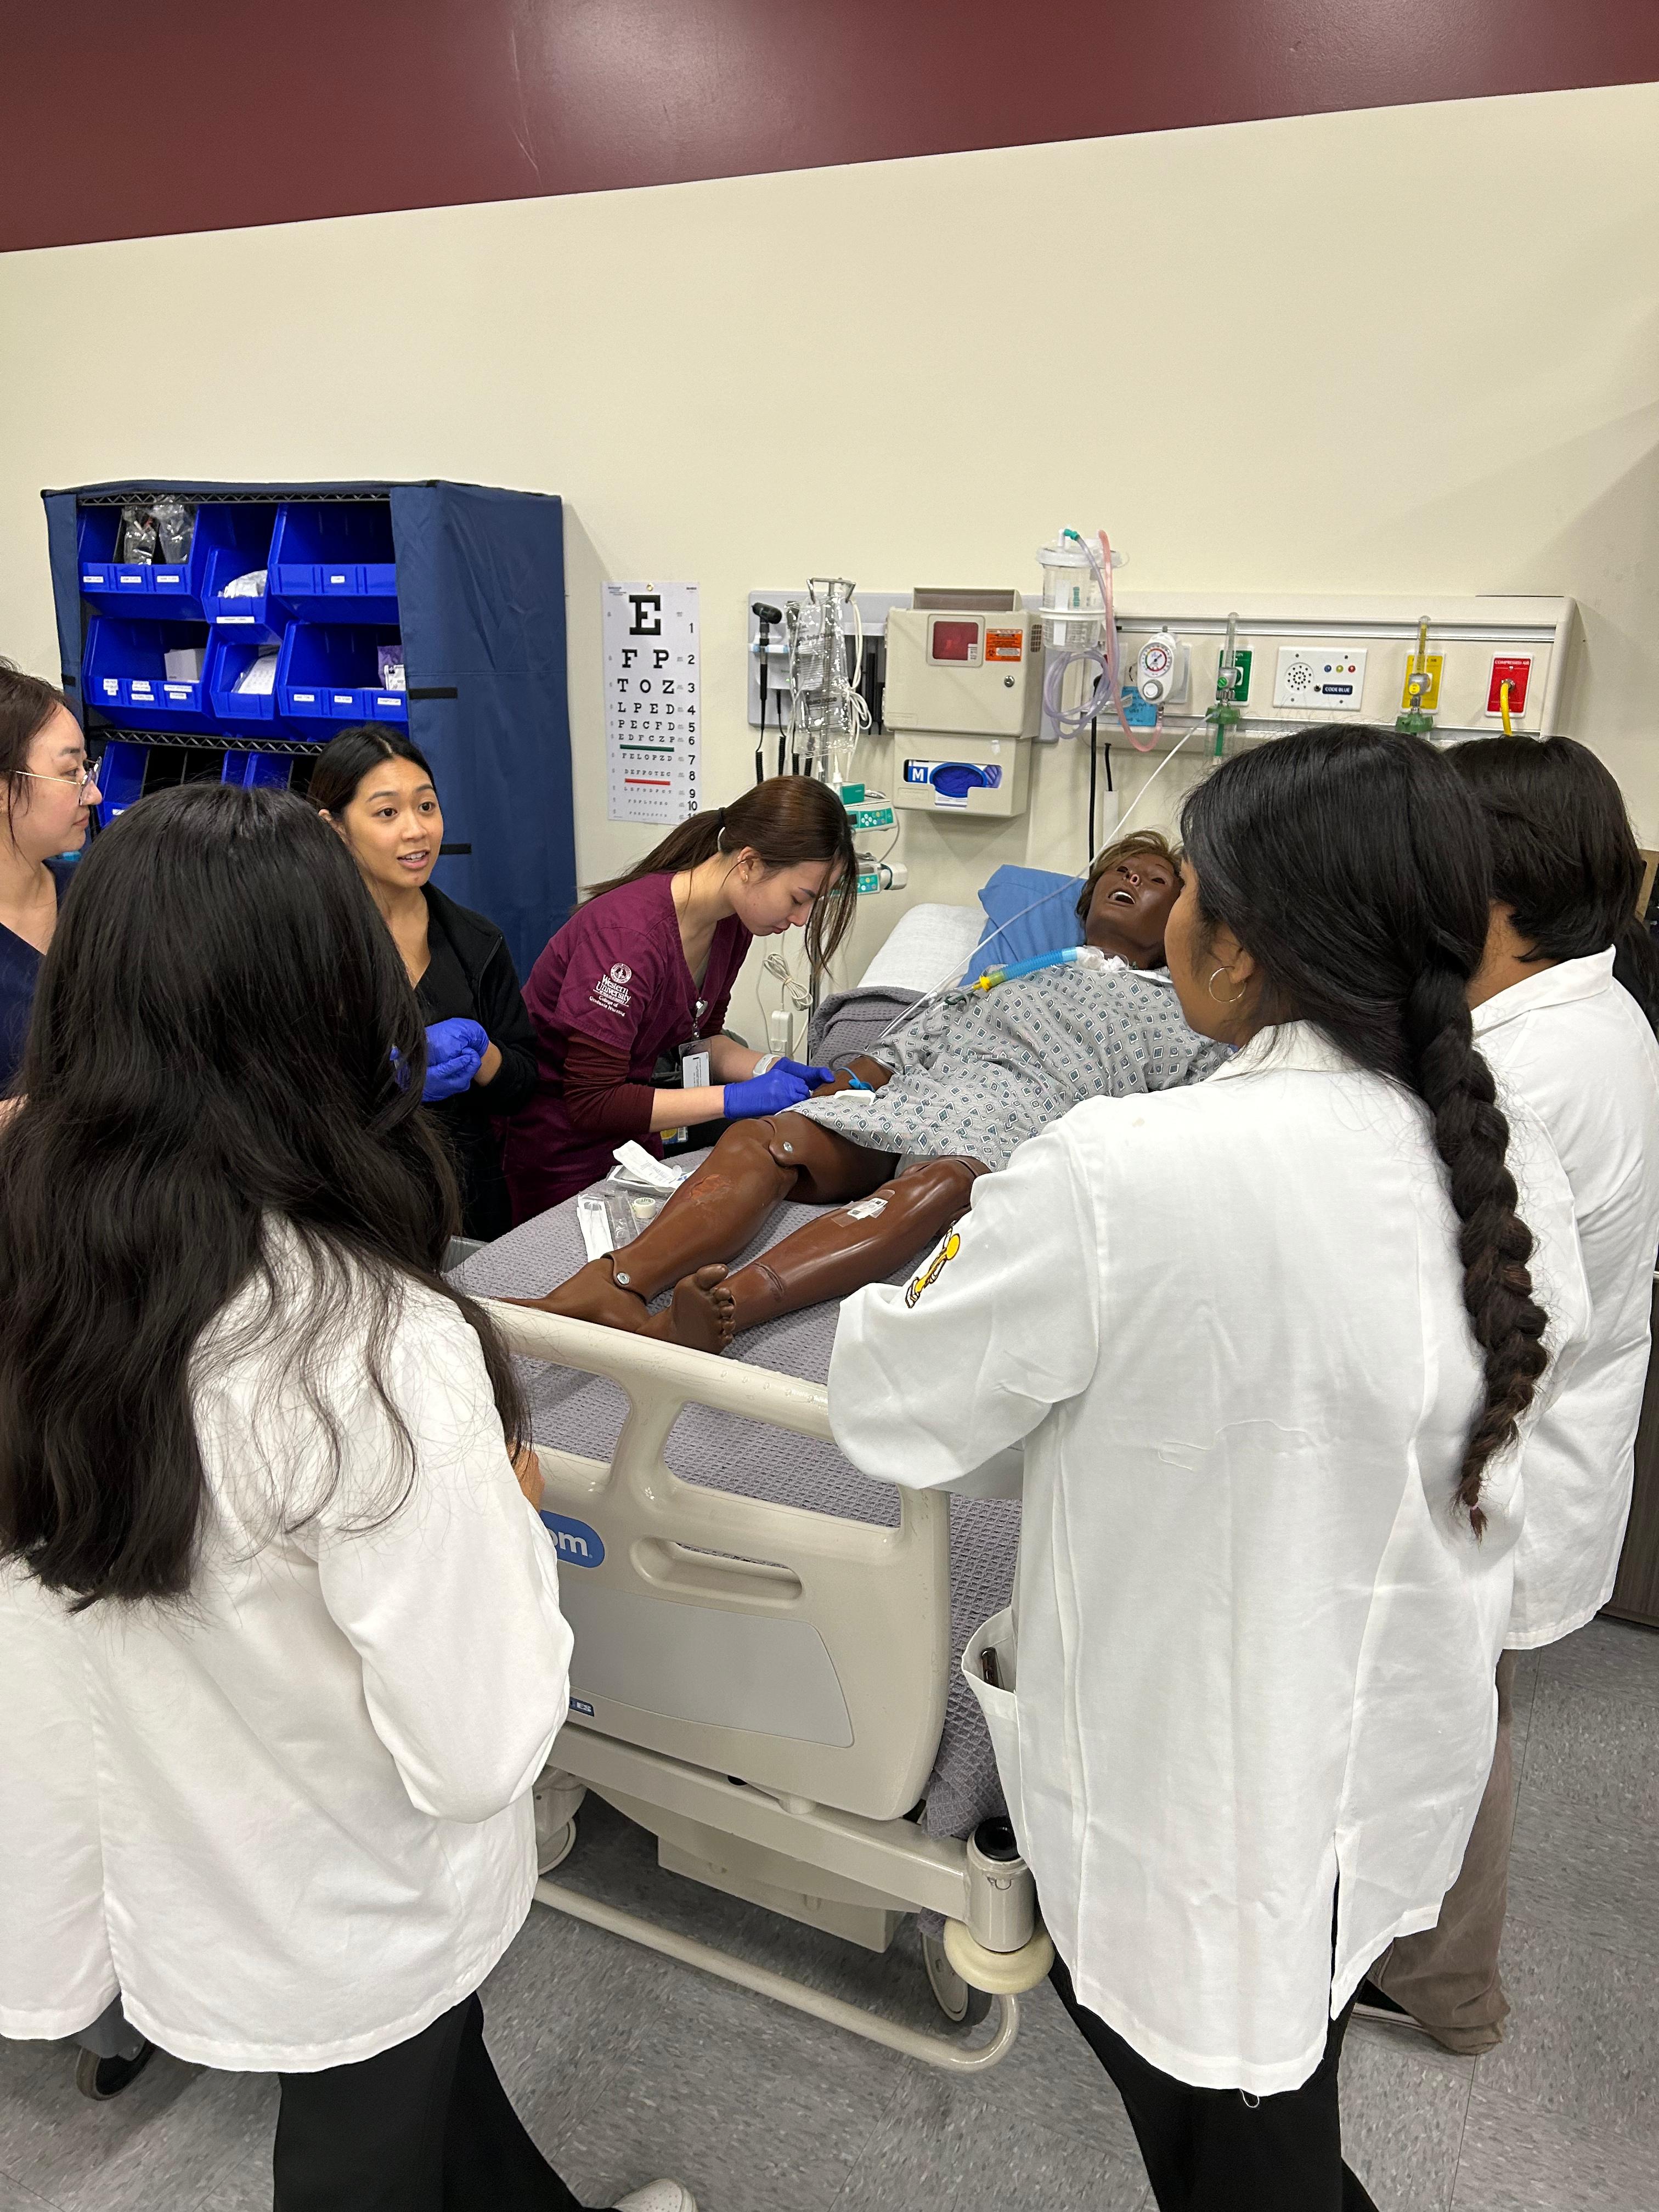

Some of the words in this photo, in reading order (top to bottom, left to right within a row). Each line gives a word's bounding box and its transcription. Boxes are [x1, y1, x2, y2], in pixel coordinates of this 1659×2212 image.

[629, 595, 661, 636] E
[689, 623, 693, 633] 1
[687, 654, 695, 664] 2
[687, 682, 695, 693] 3
[687, 705, 696, 715] 4
[688, 722, 695, 733] 5
[688, 736, 695, 746] 6
[688, 754, 696, 765] 7
[689, 771, 696, 781] 8
[912, 768, 924, 782] M
[689, 788, 696, 798] 9
[687, 800, 698, 811] 10
[602, 974, 628, 994] Western
[596, 981, 631, 1005] University
[589, 995, 608, 1009] Graduate
[607, 1005, 626, 1017] Nursing
[599, 995, 613, 1006] College
